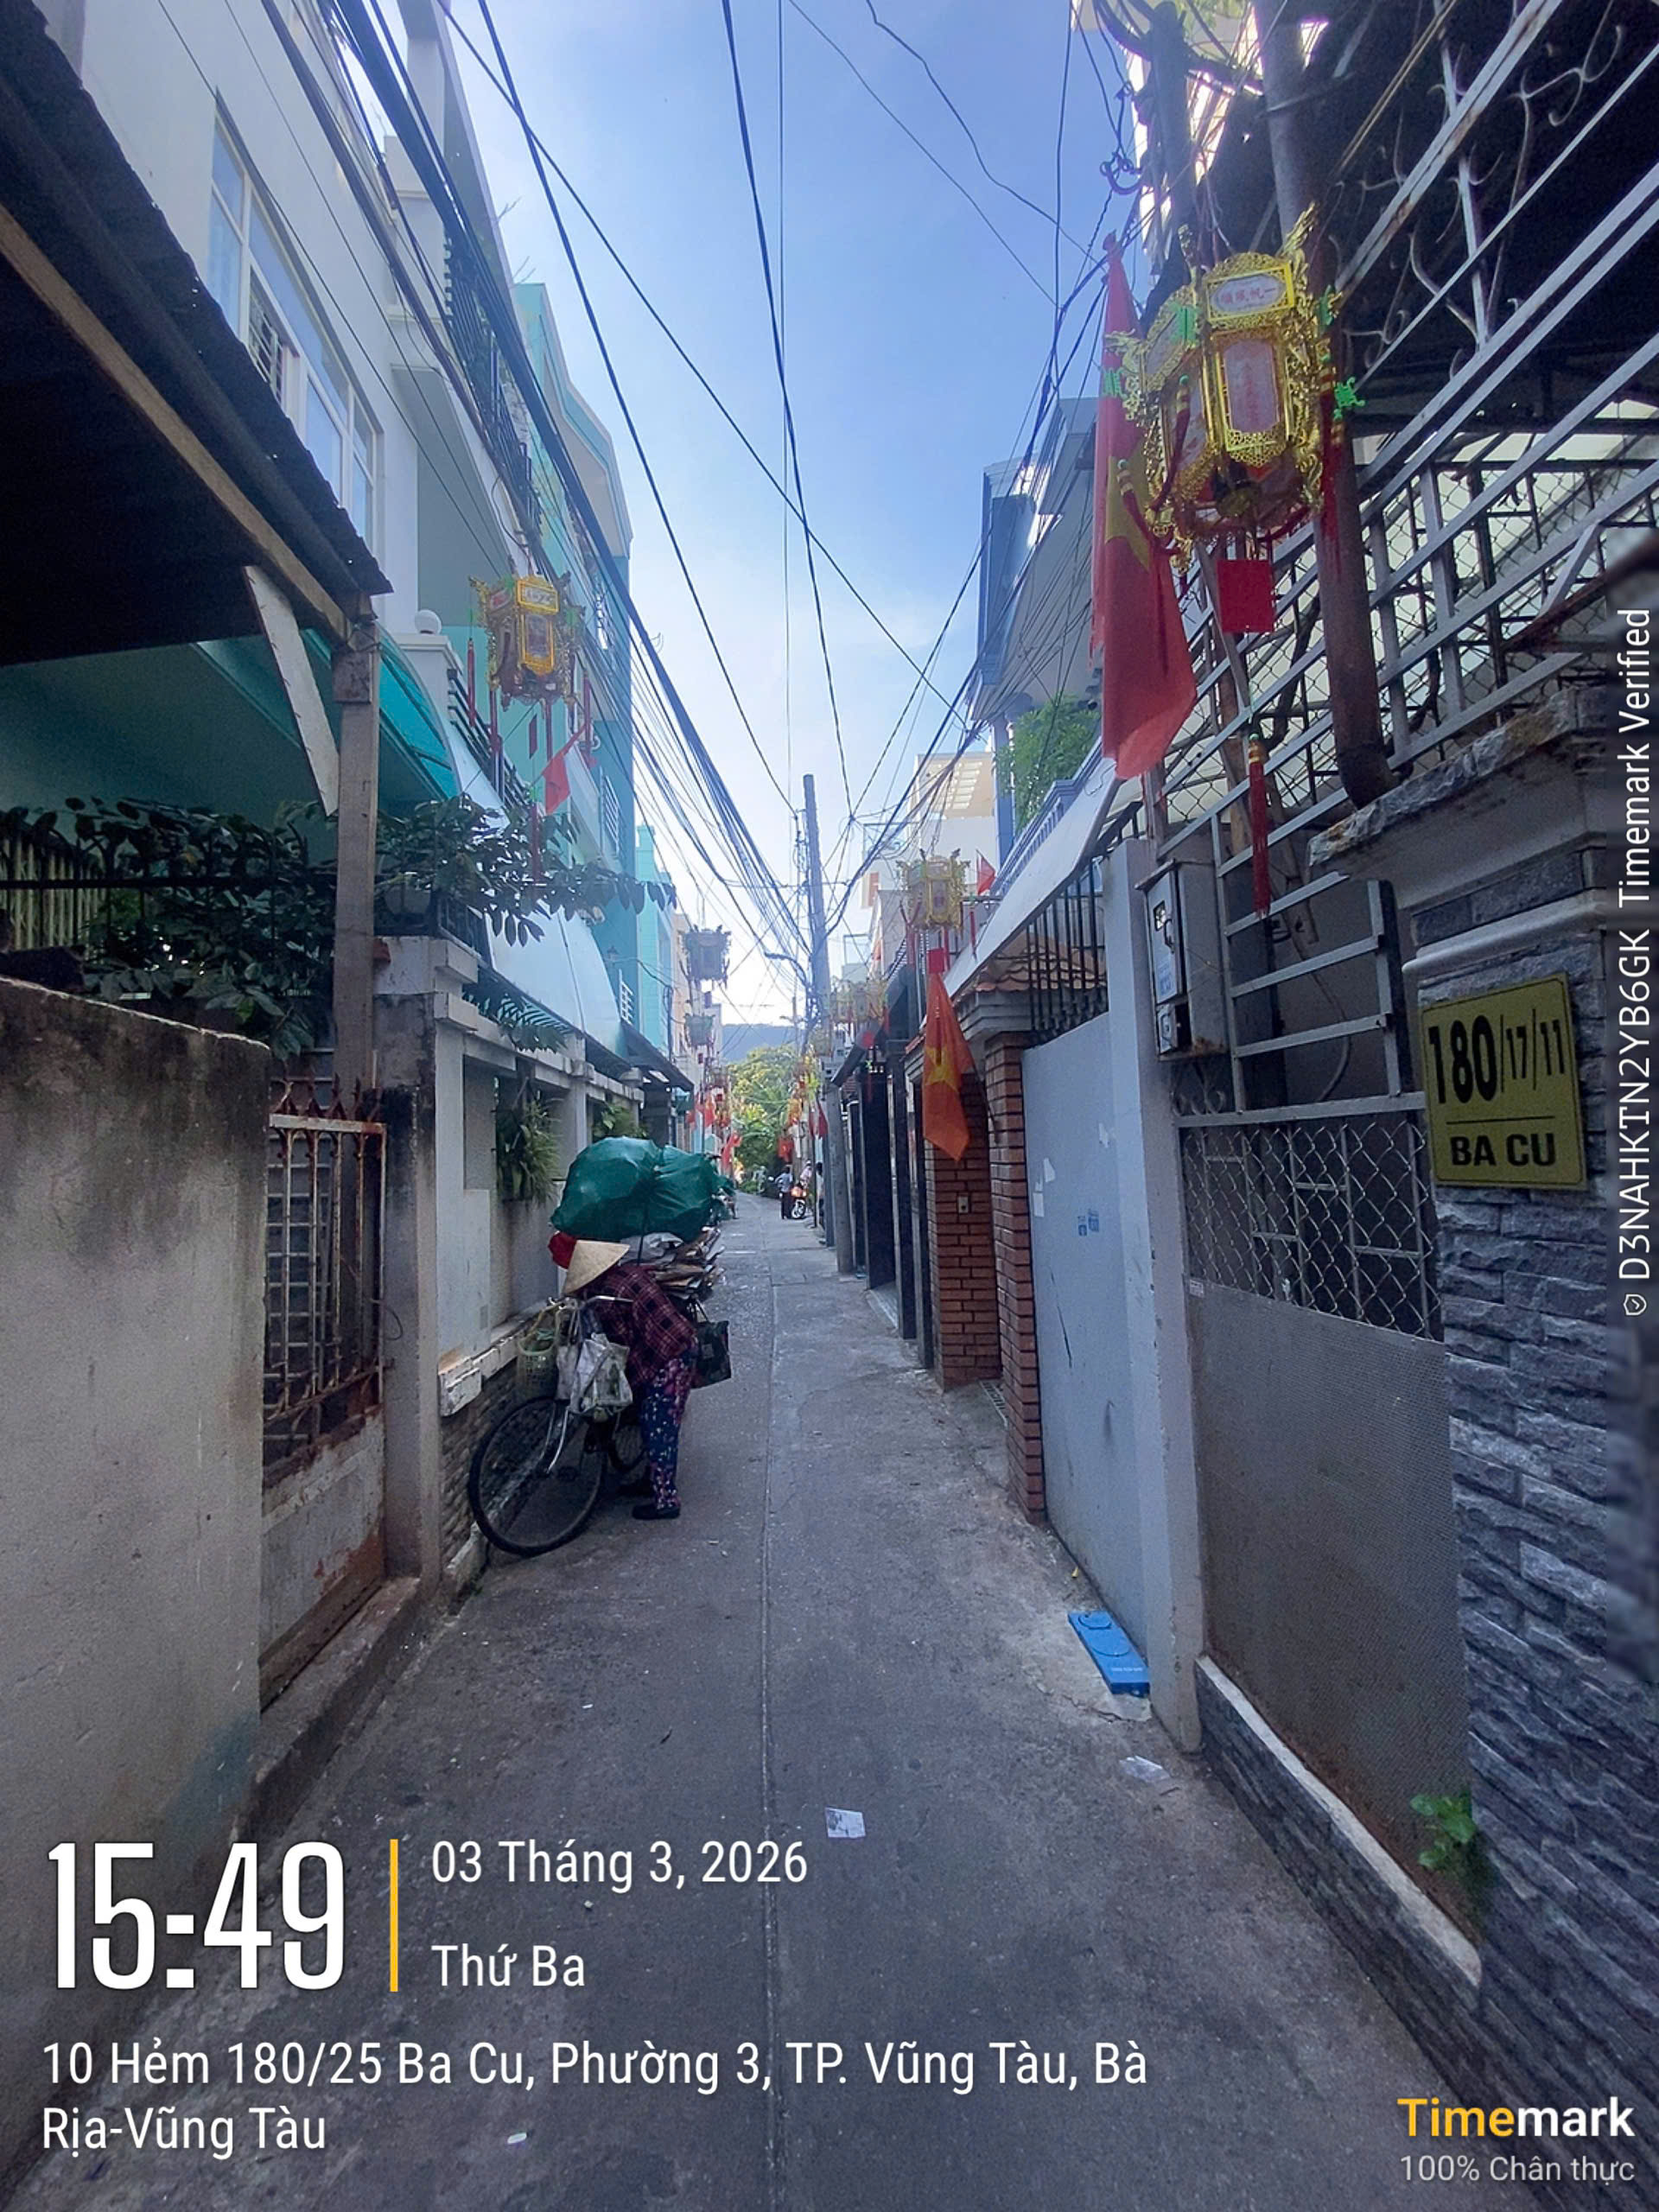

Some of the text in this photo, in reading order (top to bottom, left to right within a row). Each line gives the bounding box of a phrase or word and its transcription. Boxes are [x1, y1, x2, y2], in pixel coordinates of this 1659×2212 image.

[1427, 1007, 1565, 1105] 180/17/11
[1451, 1132, 1556, 1166] BA CU
